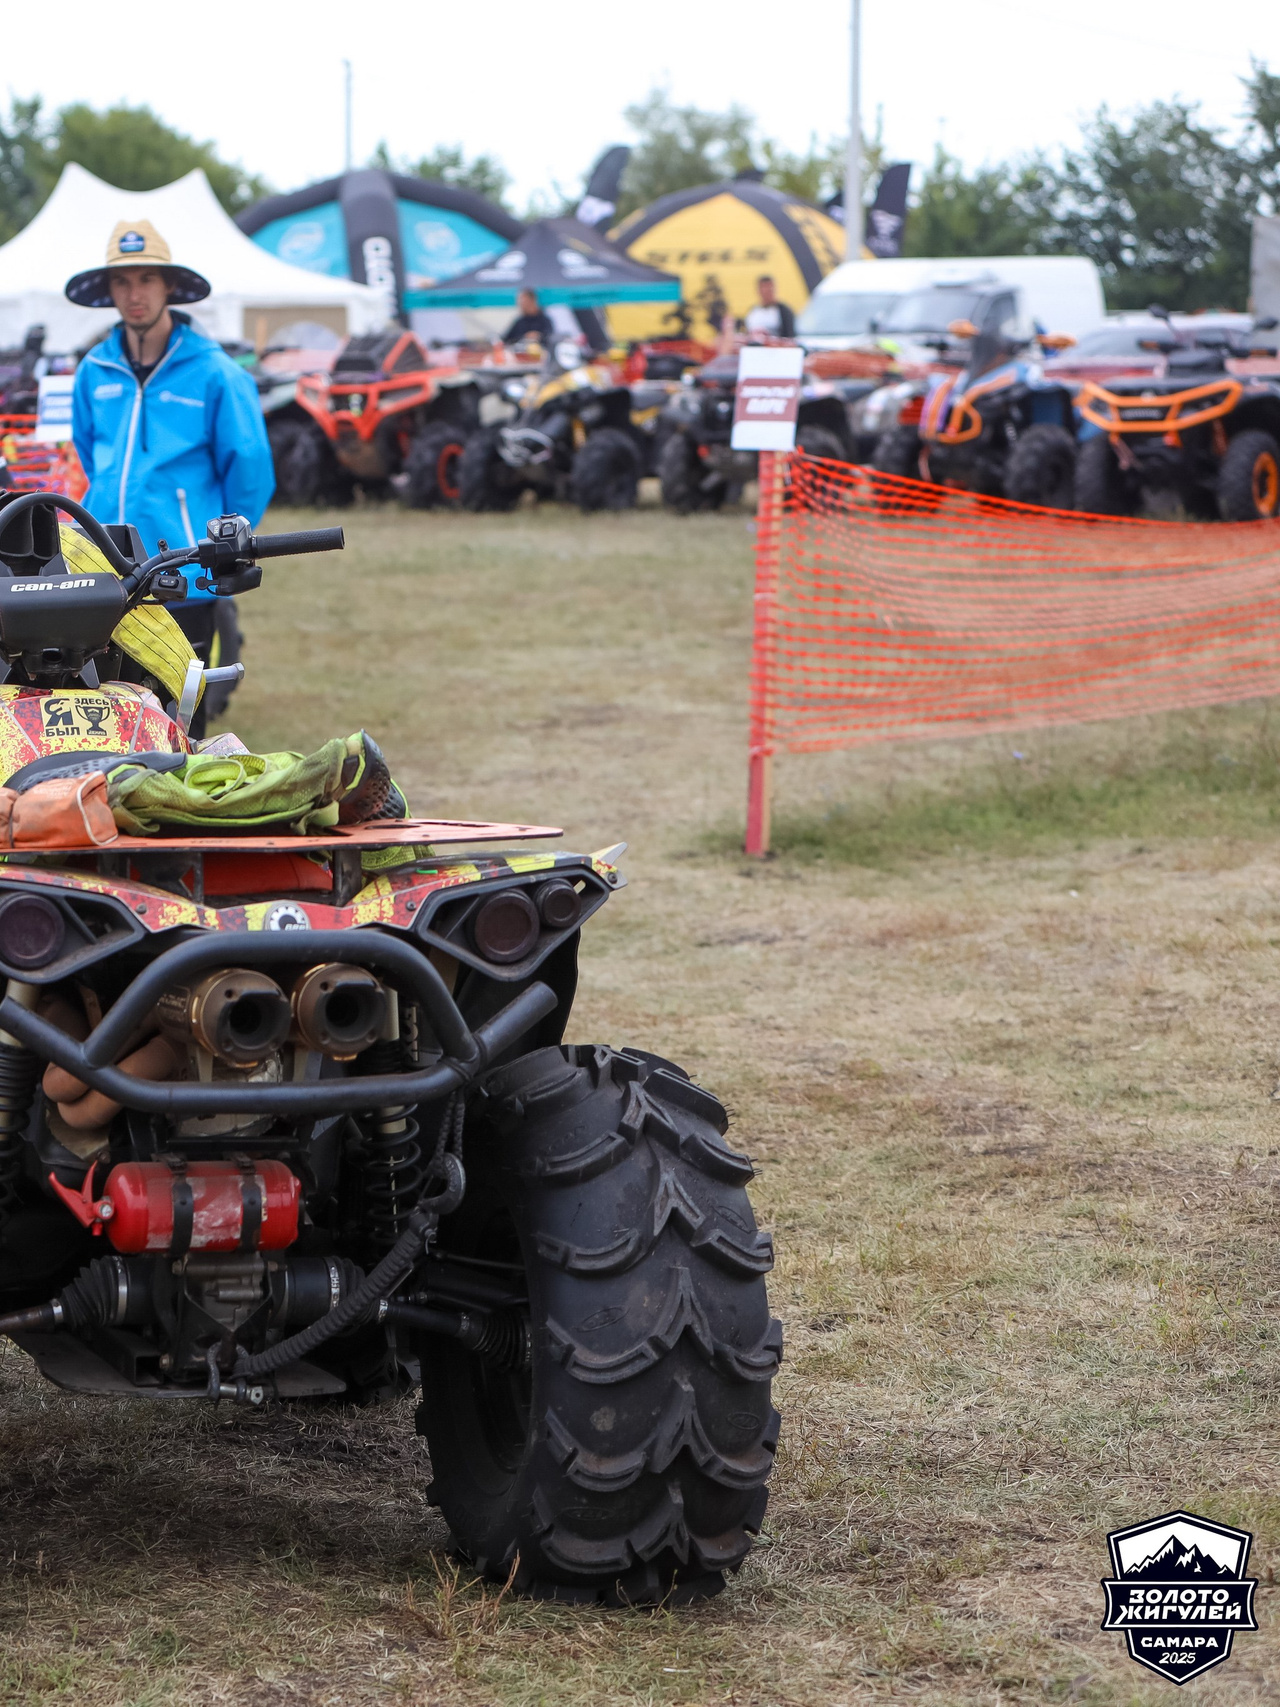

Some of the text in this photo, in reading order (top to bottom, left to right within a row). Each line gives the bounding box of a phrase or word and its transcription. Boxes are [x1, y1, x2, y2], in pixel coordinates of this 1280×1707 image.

[10, 578, 96, 593] can-am
[74, 697, 110, 706] ЗДЕСЬ
[45, 726, 81, 738] БЫЛ
